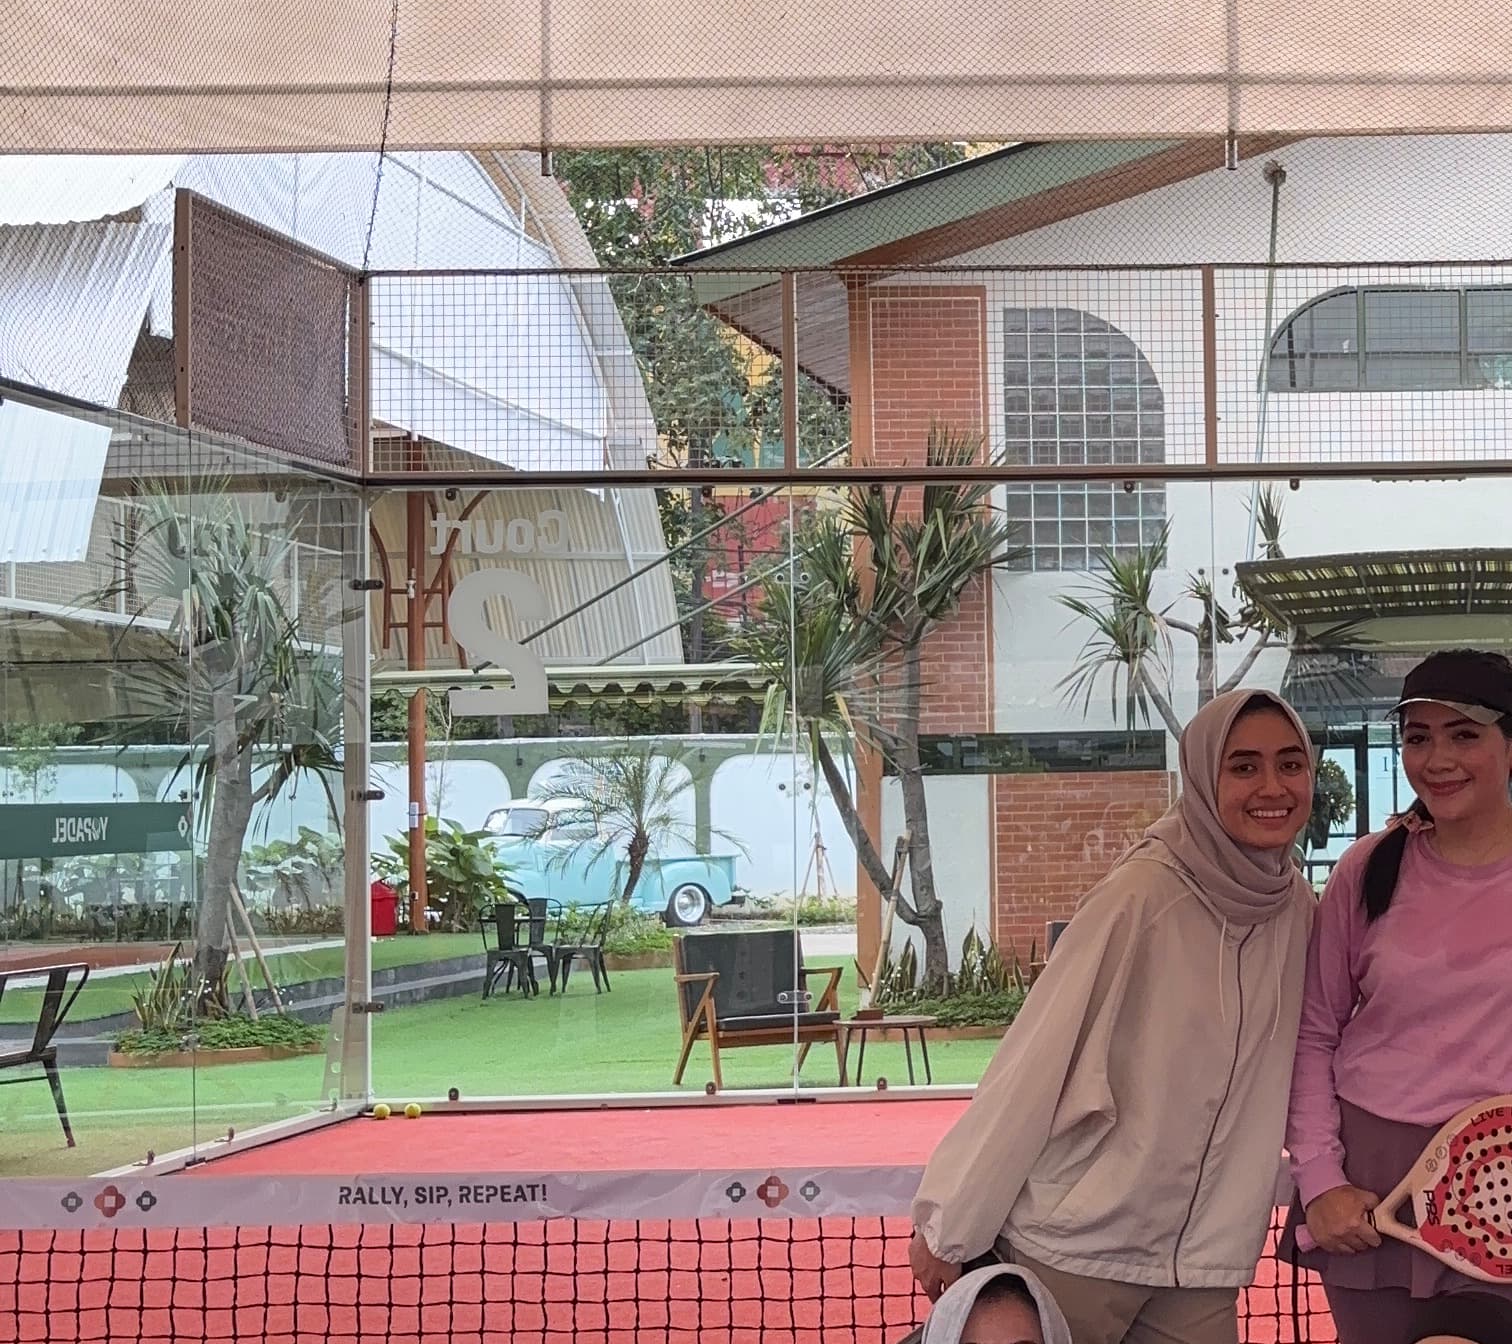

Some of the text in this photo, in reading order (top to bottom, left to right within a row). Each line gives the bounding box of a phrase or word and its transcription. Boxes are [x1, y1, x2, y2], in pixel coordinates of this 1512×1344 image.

[1471, 1107, 1504, 1127] LIVE
[338, 1184, 548, 1208] RALLY, SIP, REPEAT!
